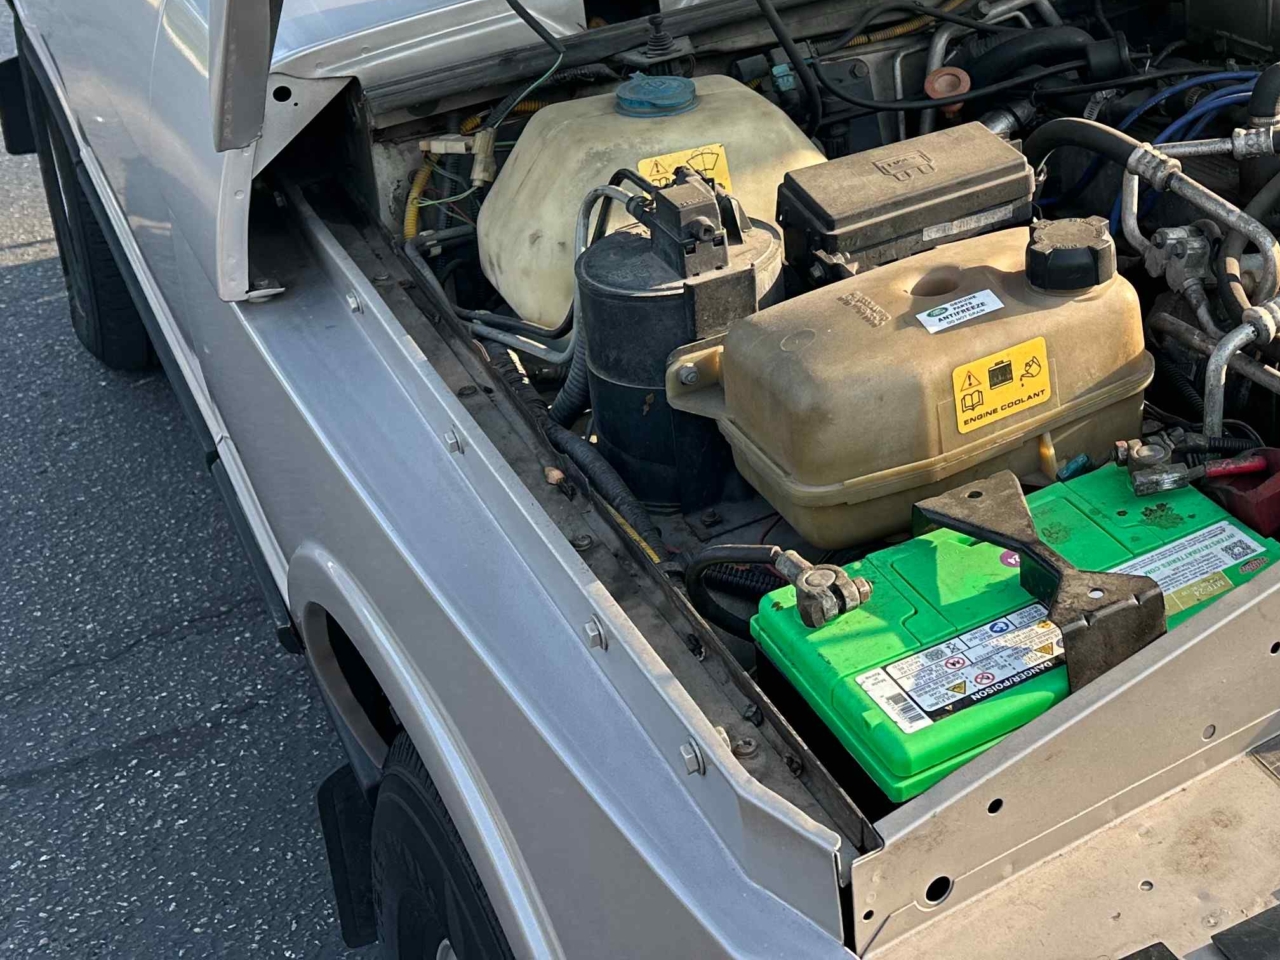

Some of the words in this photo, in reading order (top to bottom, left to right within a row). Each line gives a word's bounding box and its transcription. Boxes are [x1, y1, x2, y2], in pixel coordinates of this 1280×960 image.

[936, 300, 987, 323] ANTIFREEZE
[948, 294, 977, 307] GENUINE
[951, 300, 973, 311] PARTS
[962, 405, 998, 426] ENGINE
[999, 387, 1046, 411] COOLANT
[1142, 532, 1236, 576] INTERSTATEBATTERIES.COM
[969, 659, 1053, 702] DANGER/POISON
